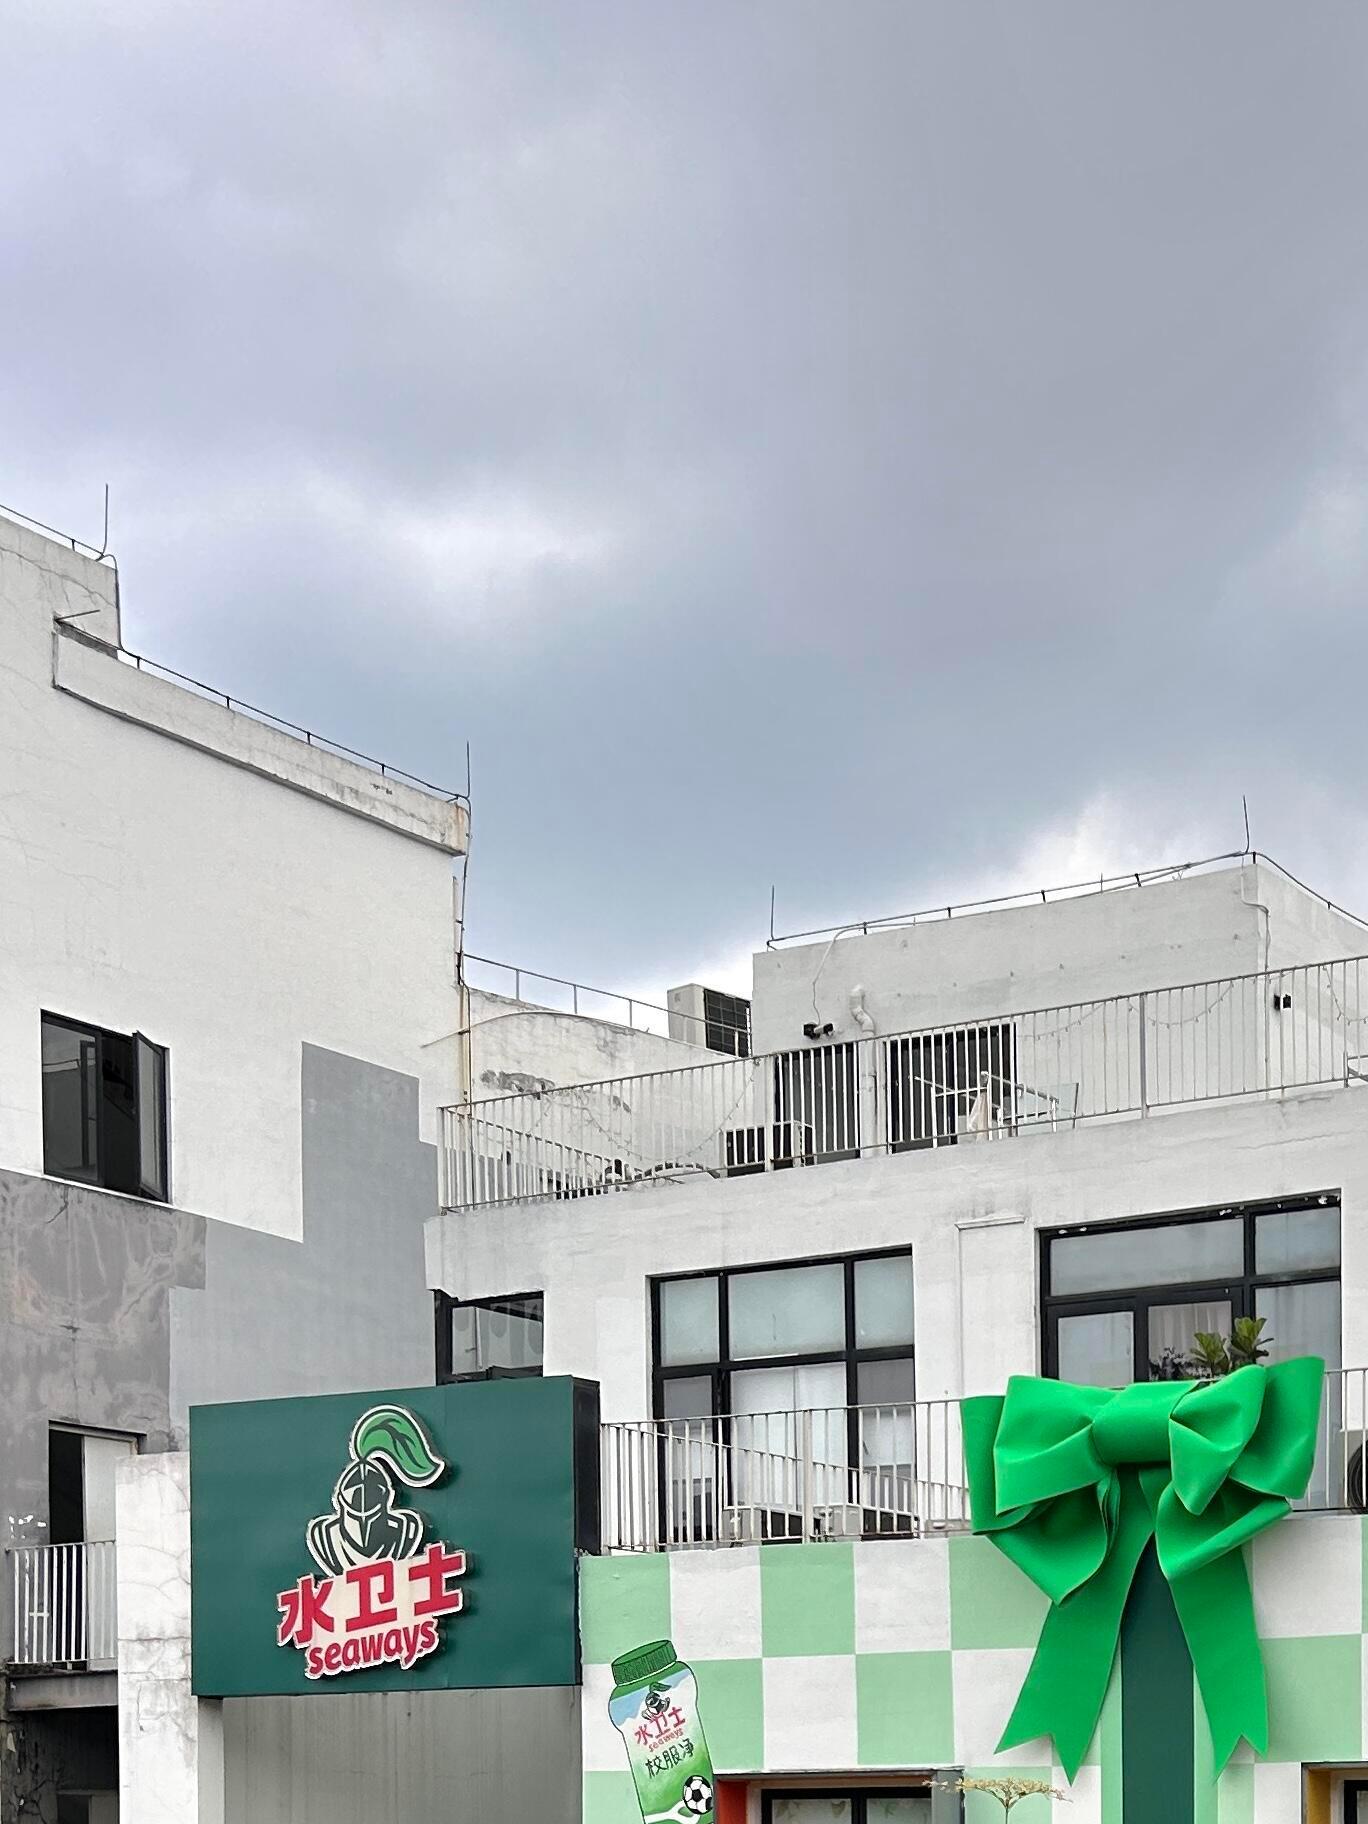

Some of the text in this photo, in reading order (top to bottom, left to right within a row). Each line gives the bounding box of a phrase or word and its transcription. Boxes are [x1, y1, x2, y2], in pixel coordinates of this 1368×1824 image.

[280, 1543, 464, 1645] 水卫士
[308, 1619, 437, 1674] seaways
[635, 1706, 686, 1746] 水卫士
[645, 1738, 695, 1777] 校服净
